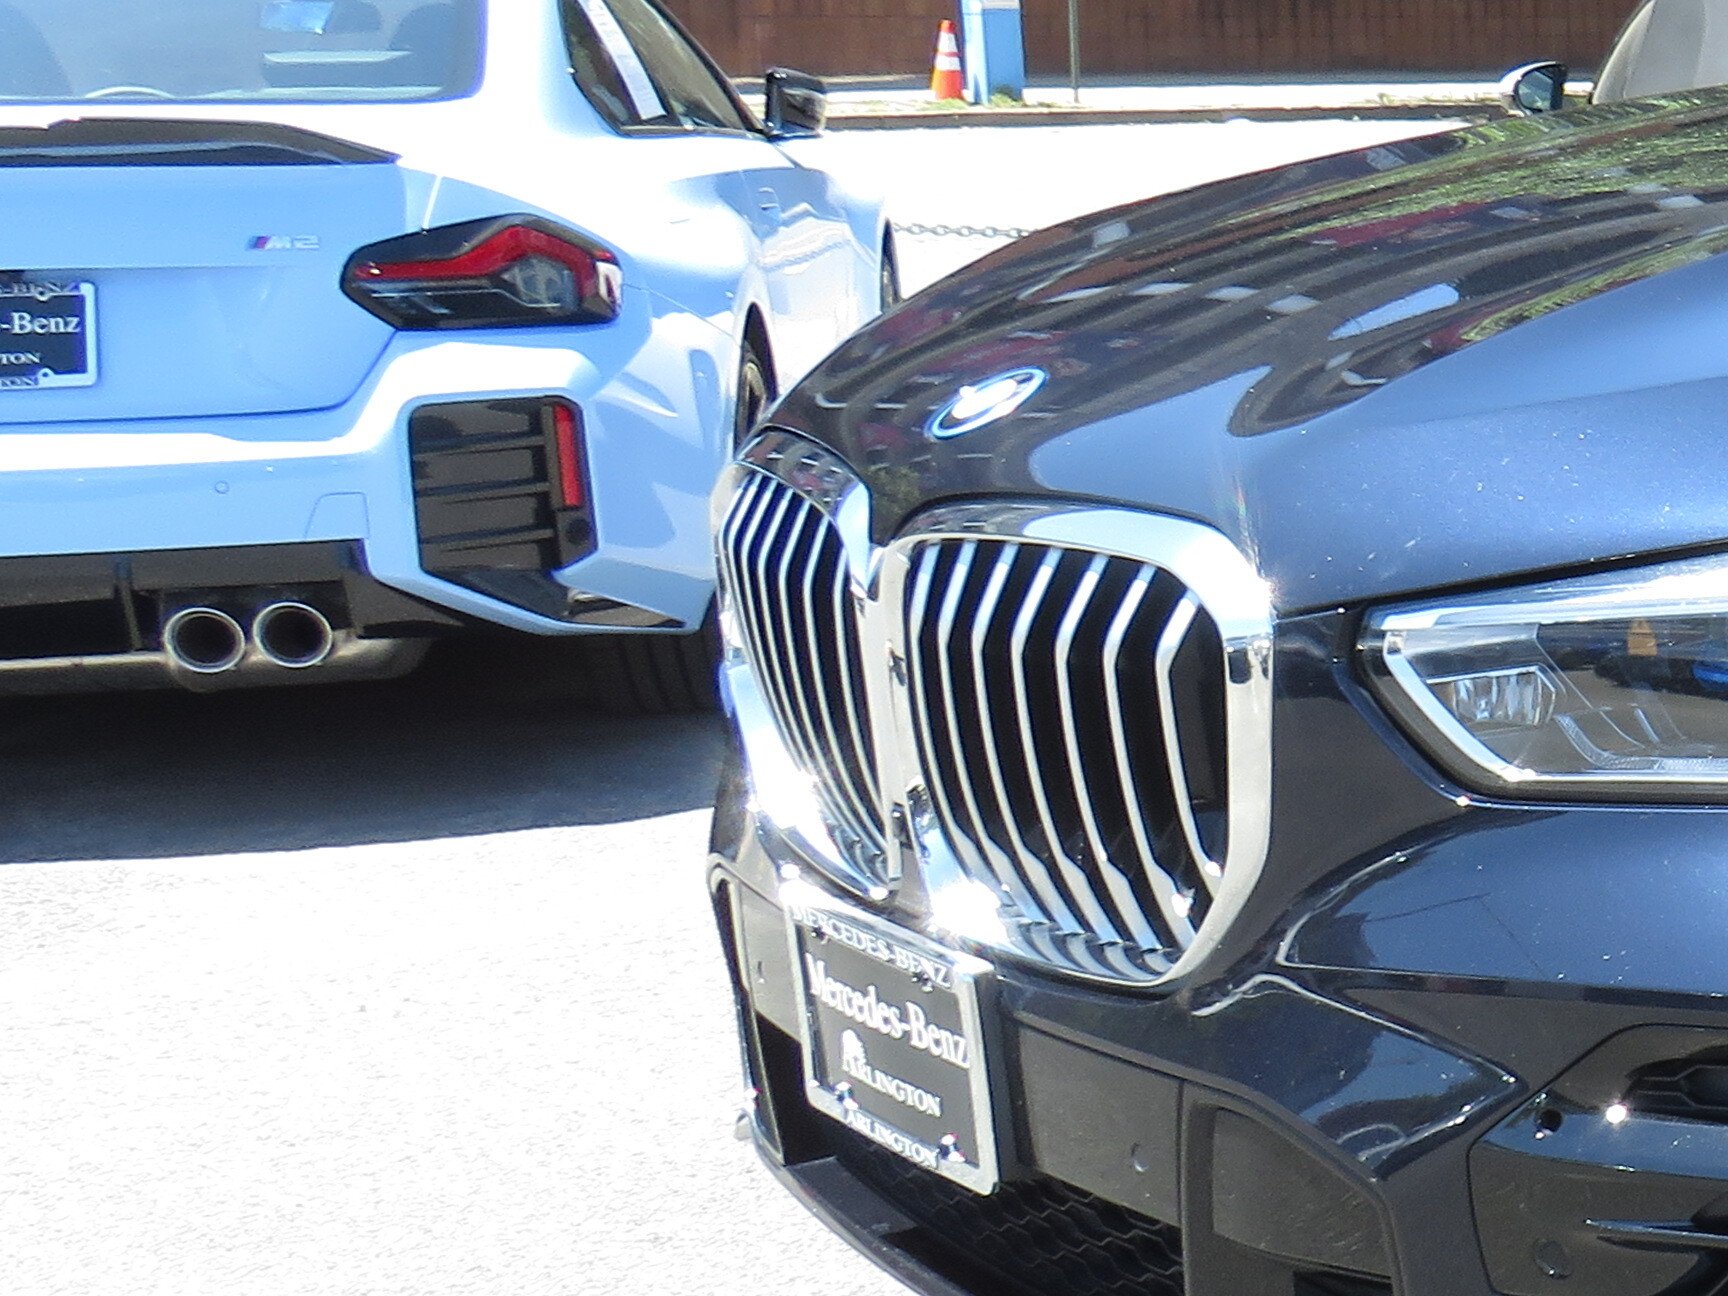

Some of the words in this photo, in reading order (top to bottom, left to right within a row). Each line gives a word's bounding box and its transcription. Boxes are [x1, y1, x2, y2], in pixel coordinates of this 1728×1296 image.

[262, 235, 320, 249] M2
[805, 952, 971, 1071] Mercedes-Benz
[842, 1050, 942, 1118] ARLINGTON
[845, 1107, 939, 1170] ARLINGTON
